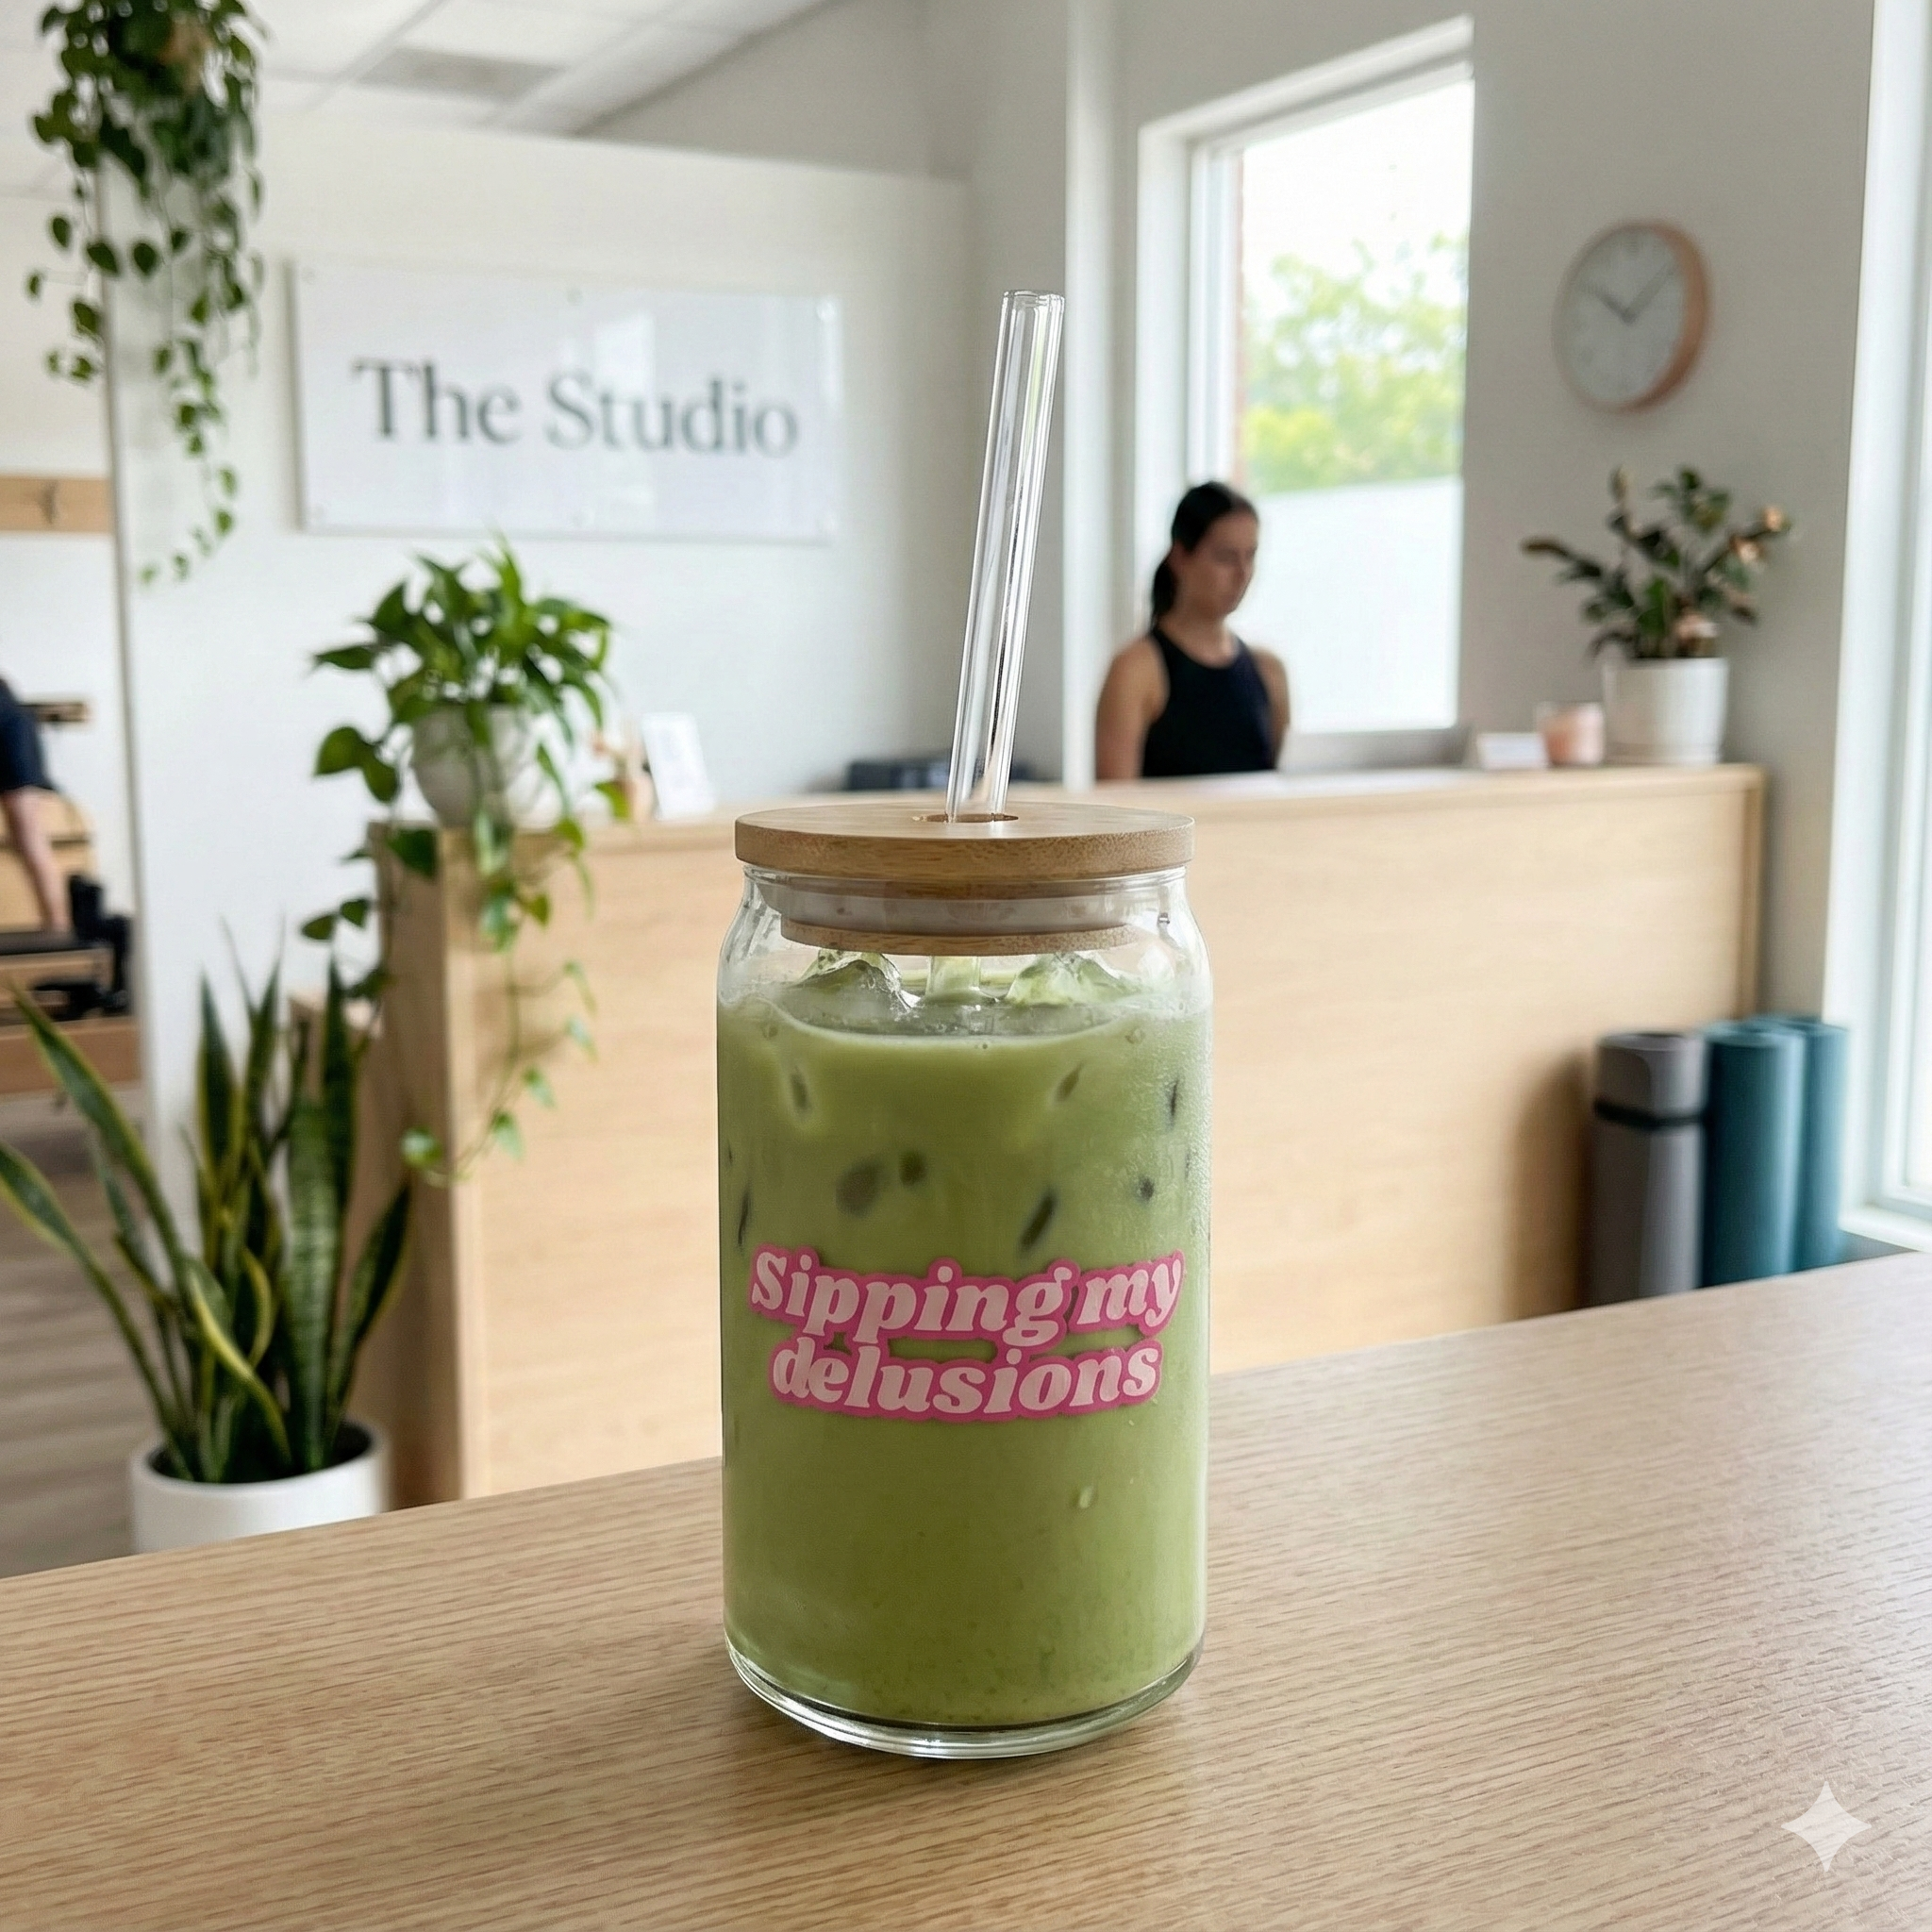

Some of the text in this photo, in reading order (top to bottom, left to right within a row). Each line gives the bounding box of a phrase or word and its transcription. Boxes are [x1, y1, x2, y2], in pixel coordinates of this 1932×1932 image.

[352, 356, 800, 457] The Studio
[750, 1249, 1183, 1349] Sipping my
[772, 1336, 1160, 1415] delusions
